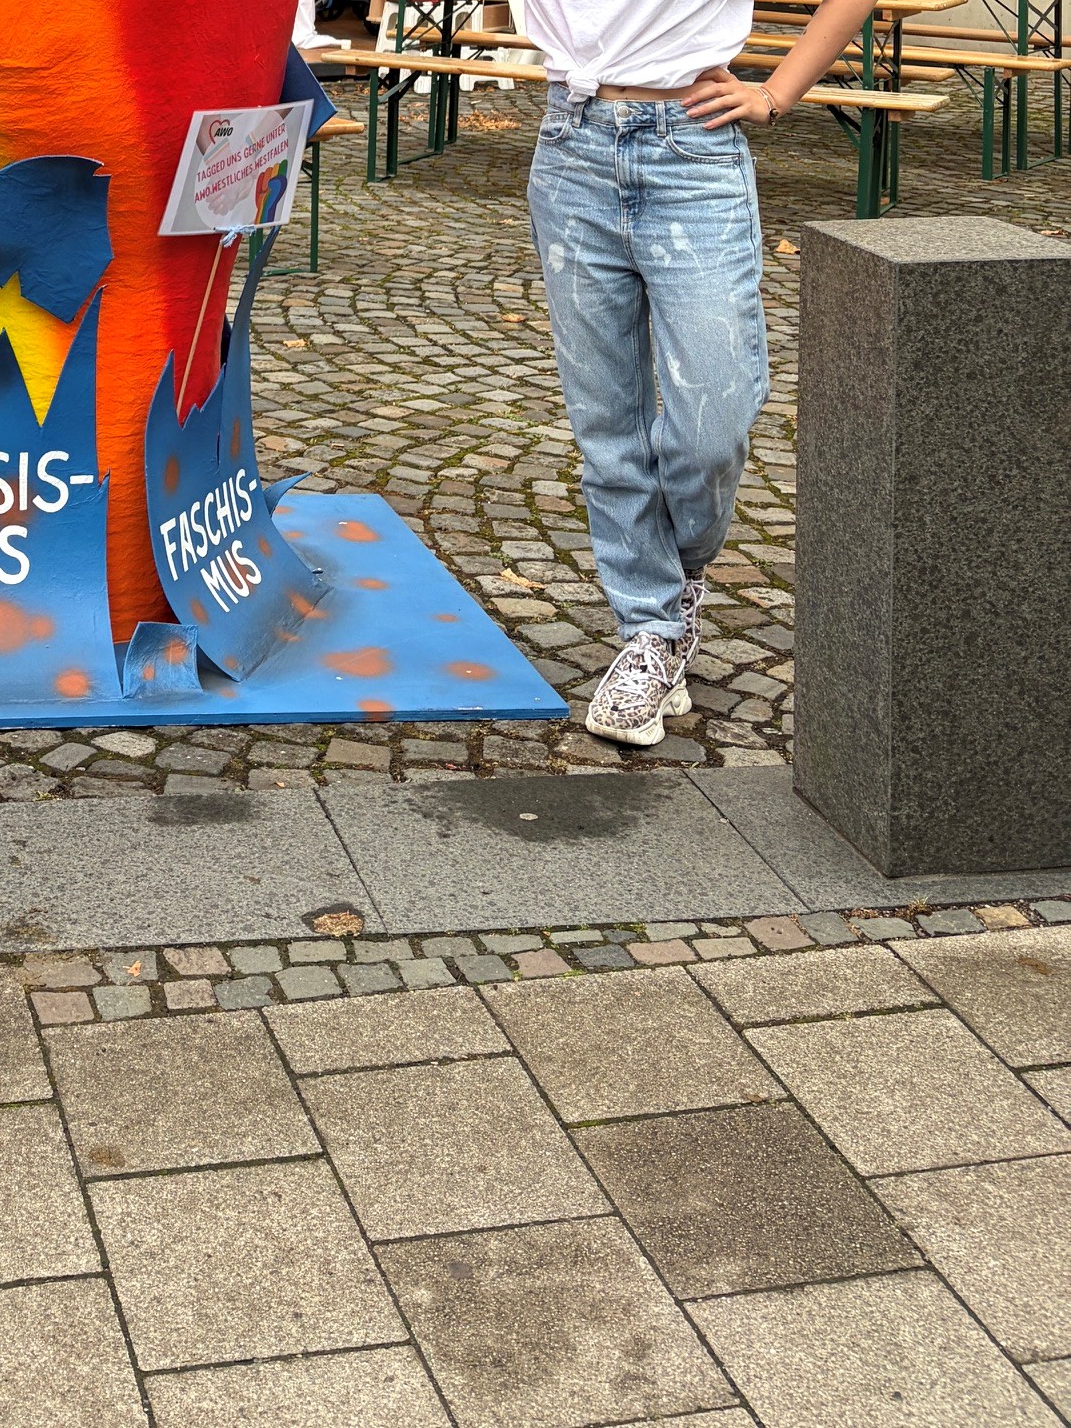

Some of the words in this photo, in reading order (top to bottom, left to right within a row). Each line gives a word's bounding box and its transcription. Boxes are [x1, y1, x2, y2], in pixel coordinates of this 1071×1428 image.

[196, 159, 226, 183] TAGGED
[226, 149, 242, 168] UNS
[243, 137, 266, 159] GERNE
[266, 122, 286, 144] UNTER
[213, 126, 234, 138] AWO
[159, 468, 258, 581] FASCHIS-
[200, 539, 262, 613] MUS
